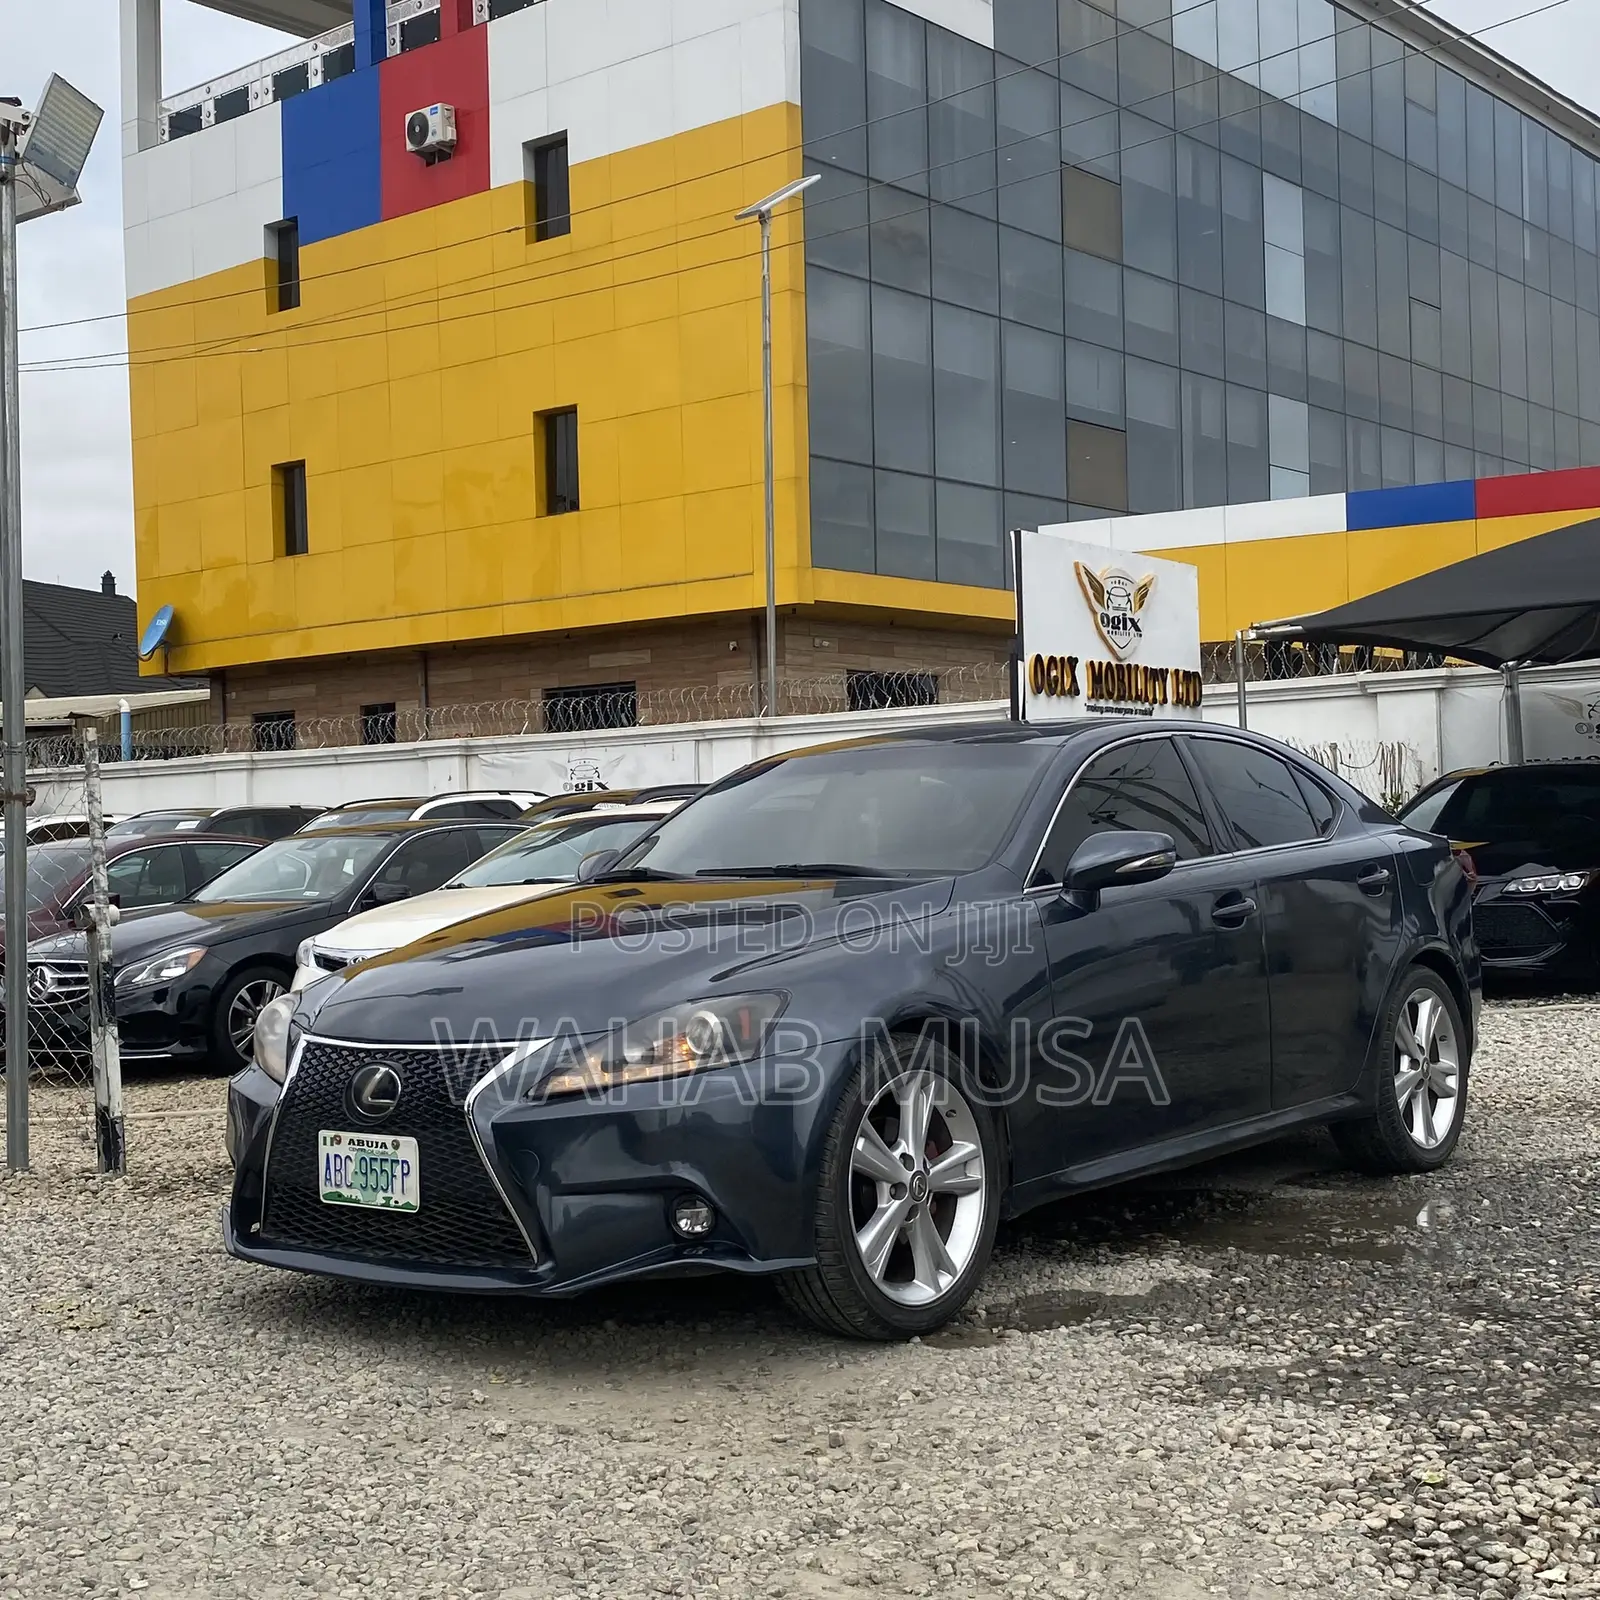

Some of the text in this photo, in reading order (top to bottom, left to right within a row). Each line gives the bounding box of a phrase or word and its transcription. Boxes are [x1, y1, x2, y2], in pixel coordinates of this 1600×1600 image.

[1029, 653, 1202, 707] OGIX MOBILITY LTD
[348, 1138, 389, 1150] ABUJA
